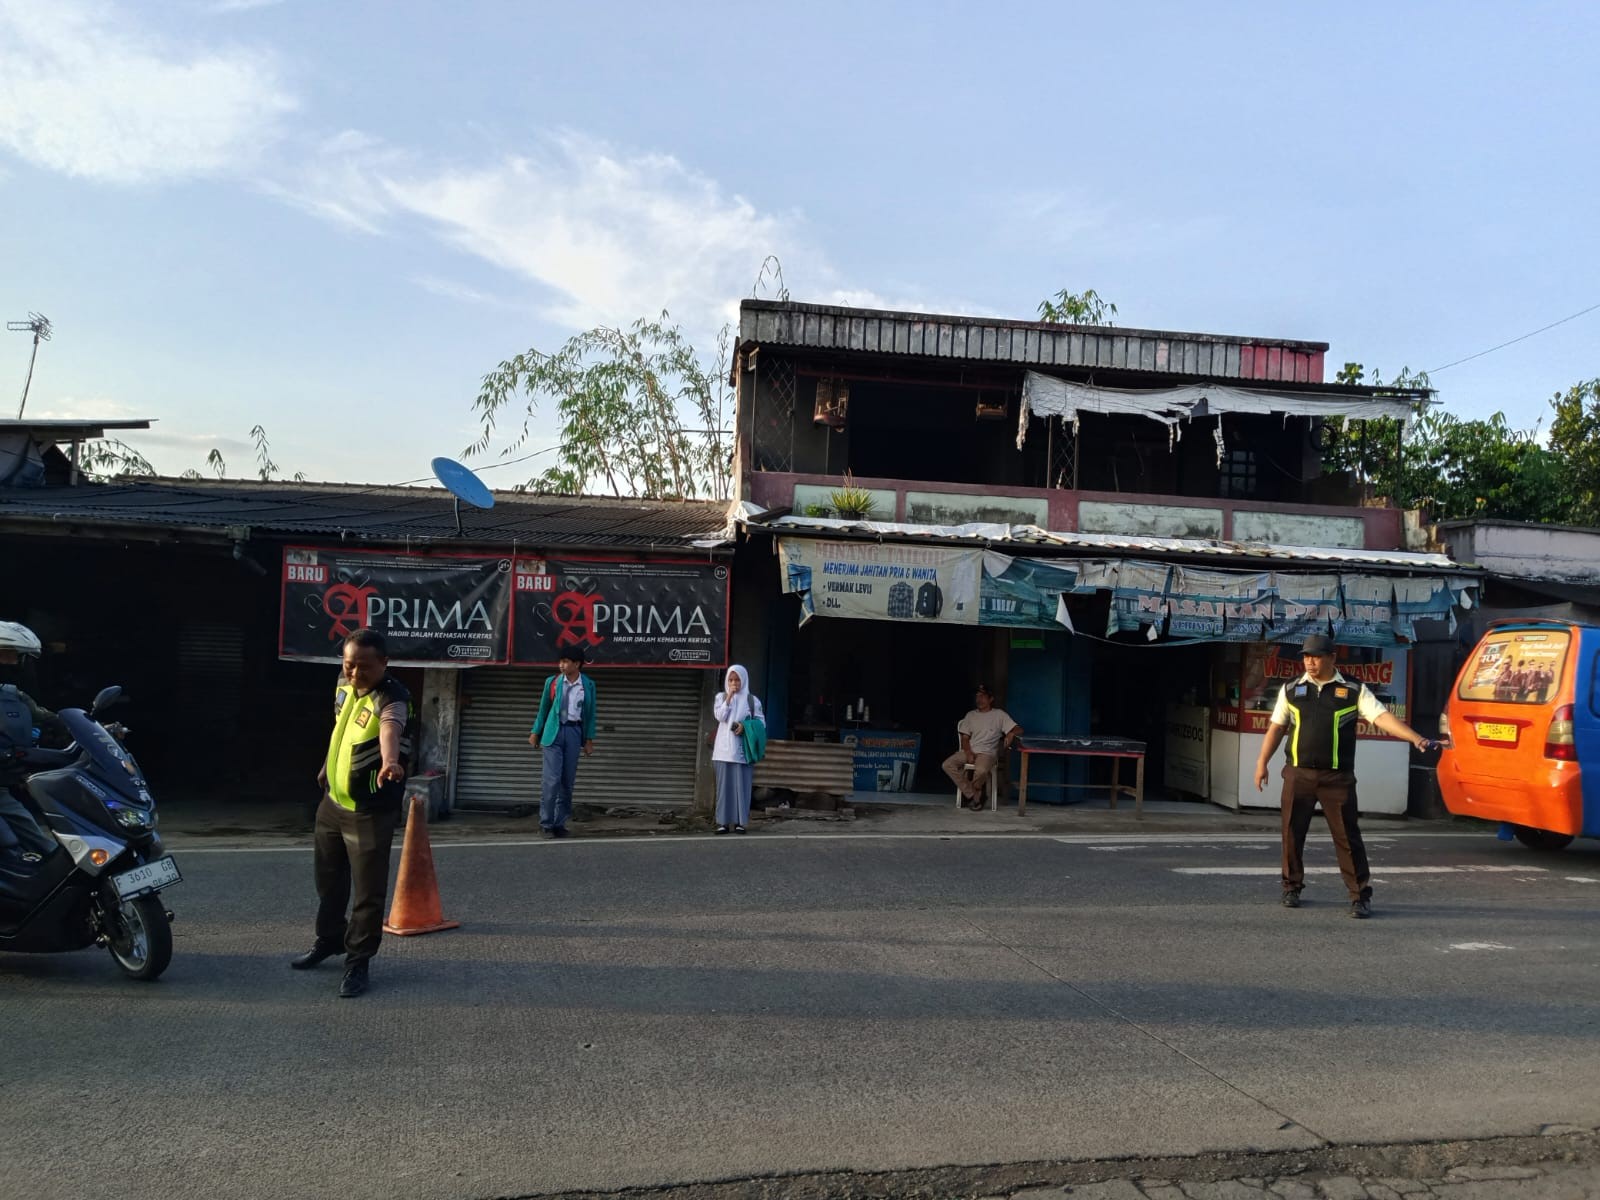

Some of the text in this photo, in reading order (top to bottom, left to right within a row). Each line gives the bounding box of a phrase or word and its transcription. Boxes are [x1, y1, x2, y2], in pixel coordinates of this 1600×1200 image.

[815, 542, 880, 562] MINANG
[287, 565, 324, 582] BARU
[823, 562, 859, 575] MENERIMA
[860, 565, 888, 578] JAHITAN
[889, 566, 905, 579] PRIA
[912, 568, 937, 580] WANITA
[517, 575, 552, 590] BARU
[827, 581, 854, 593] VERMAK
[160, 860, 174, 872] GB
